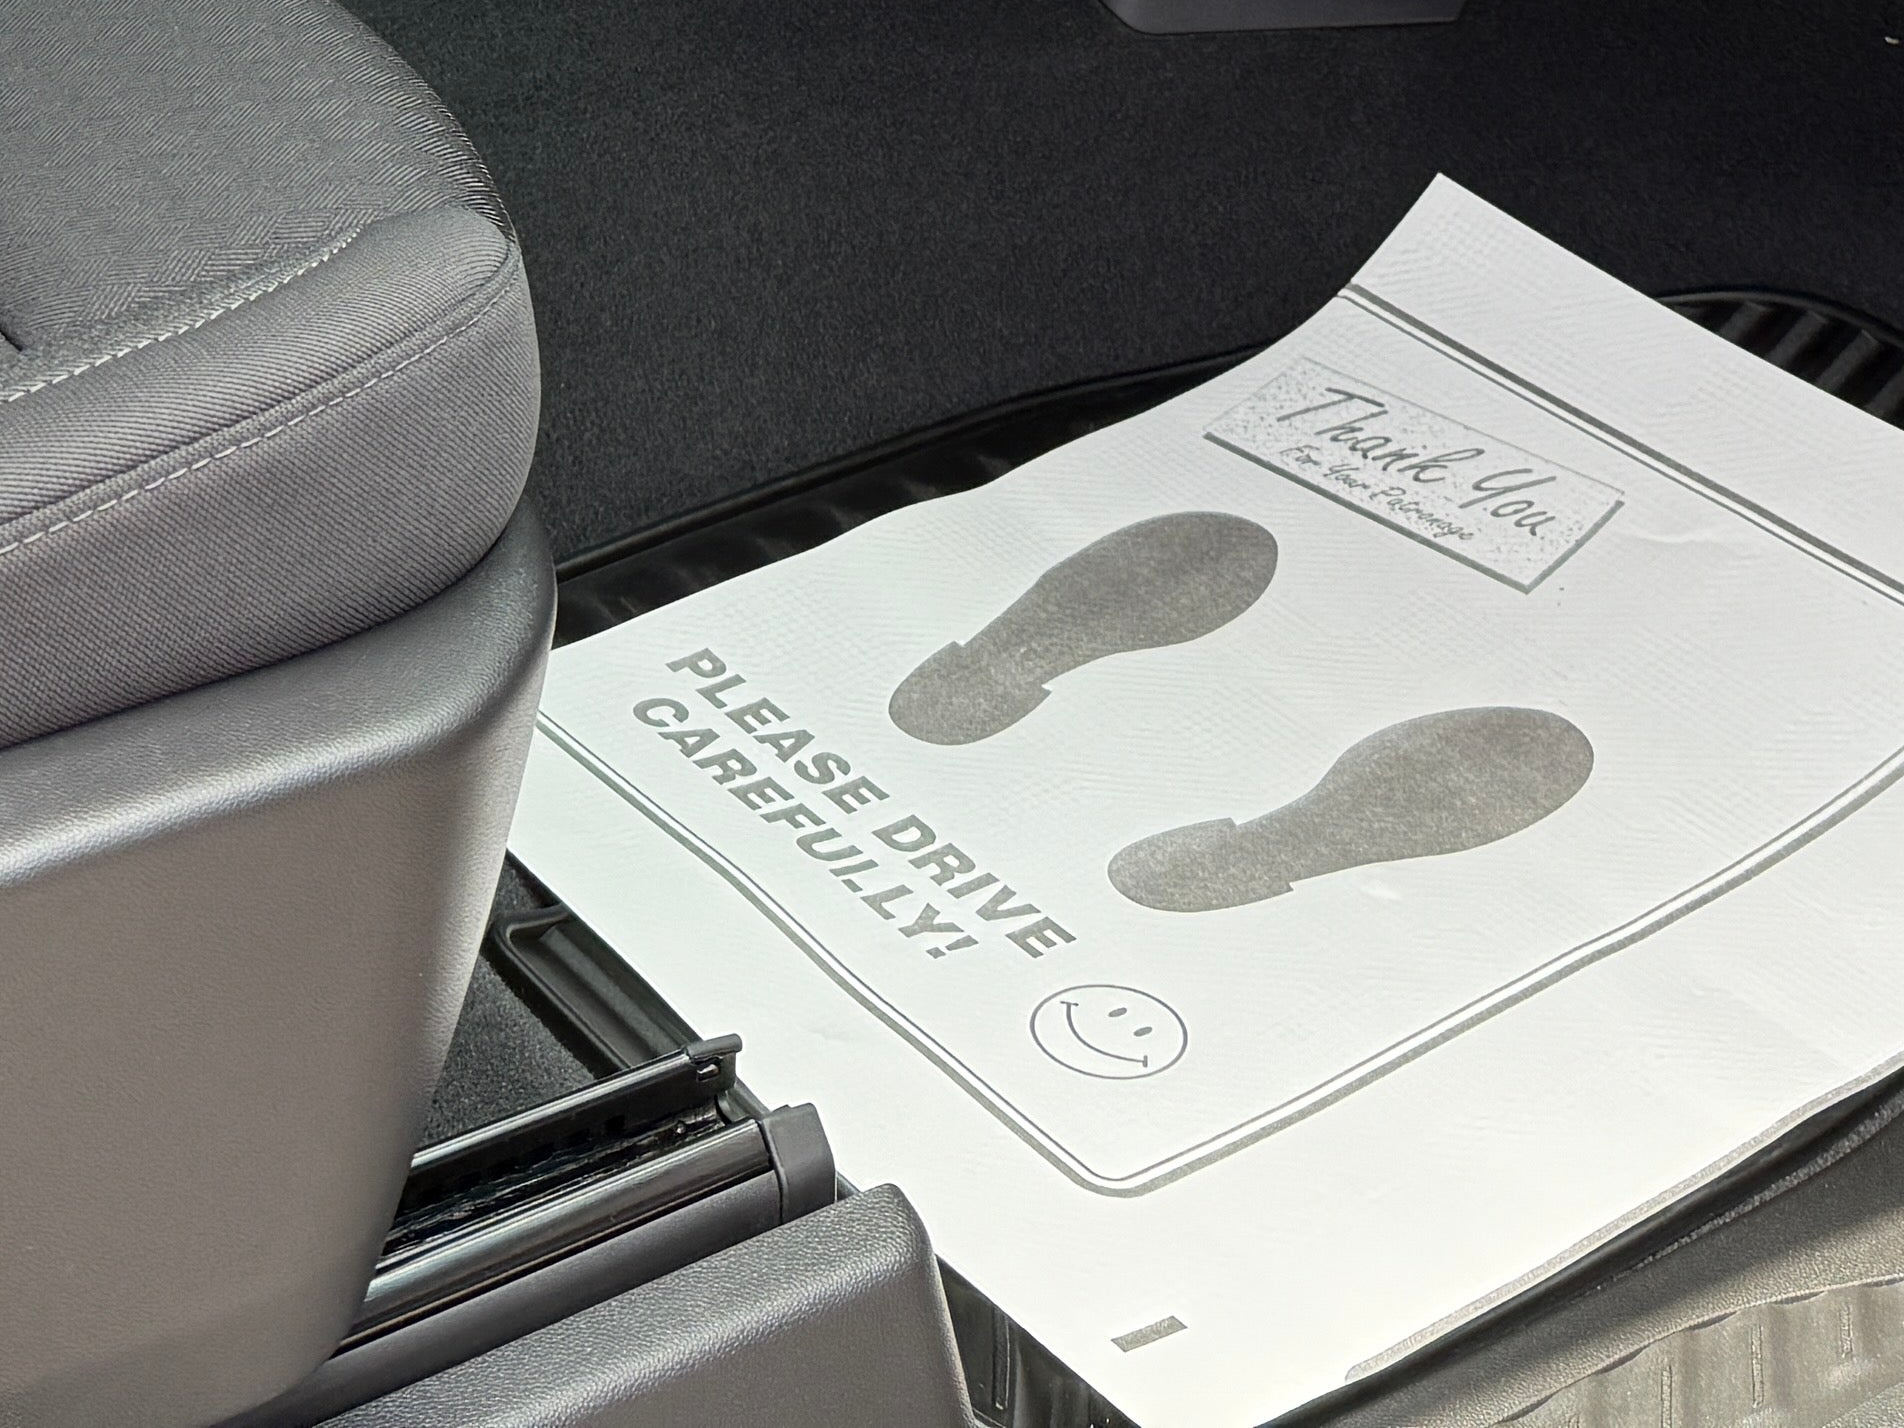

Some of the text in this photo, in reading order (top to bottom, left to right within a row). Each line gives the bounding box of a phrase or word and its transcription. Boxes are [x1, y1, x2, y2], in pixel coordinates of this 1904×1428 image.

[1277, 387, 1557, 536] Thank You
[1280, 444, 1475, 541] For Your Patronage
[632, 697, 980, 960] CAREFULLY!
[665, 647, 1077, 959] PLEASE DRIVE
